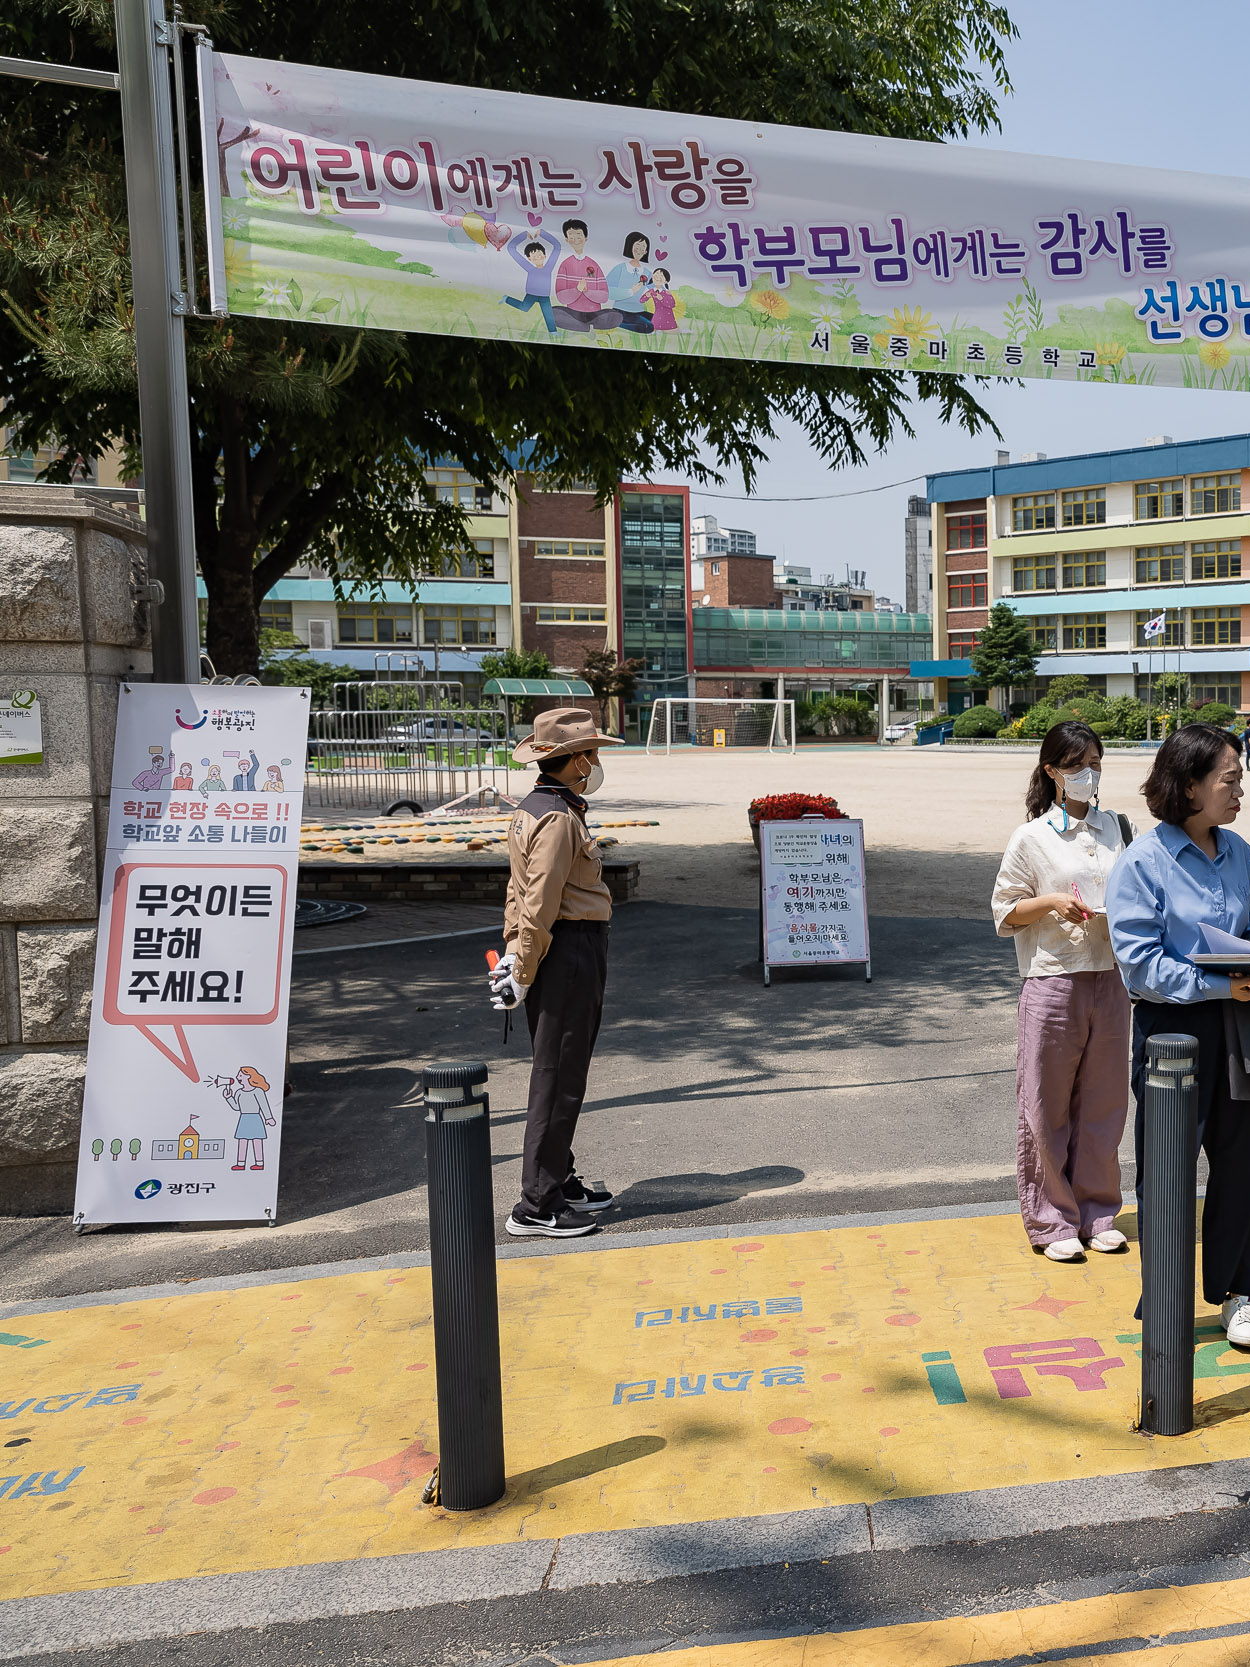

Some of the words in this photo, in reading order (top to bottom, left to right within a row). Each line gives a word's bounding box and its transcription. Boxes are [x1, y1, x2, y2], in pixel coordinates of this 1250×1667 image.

[250, 137, 582, 212] 어린이에게는
[598, 141, 753, 210] 사랑을
[693, 218, 1026, 289] 학부모님에게는
[1034, 211, 1172, 276] 감사를
[0, 711, 32, 719] 네이버스
[211, 716, 256, 731] 행복광진
[123, 801, 162, 821] 학교
[169, 802, 208, 821] 현장
[214, 803, 268, 821] 속으로
[122, 823, 182, 843] 학교앞
[187, 824, 225, 843] 소통
[231, 825, 287, 844] 나들이
[825, 852, 849, 864] 위해
[789, 872, 842, 884] 학부모님은
[135, 884, 273, 918] 무엇이든
[787, 886, 846, 899] 여기까지만
[784, 902, 815, 913] 동행해
[818, 901, 850, 911] 주세요
[820, 924, 846, 932] 가지고
[132, 927, 202, 960] 말해
[127, 970, 244, 1004] 주세요!
[166, 1182, 217, 1195] 광진구
[612, 1365, 807, 1406] 황소자리
